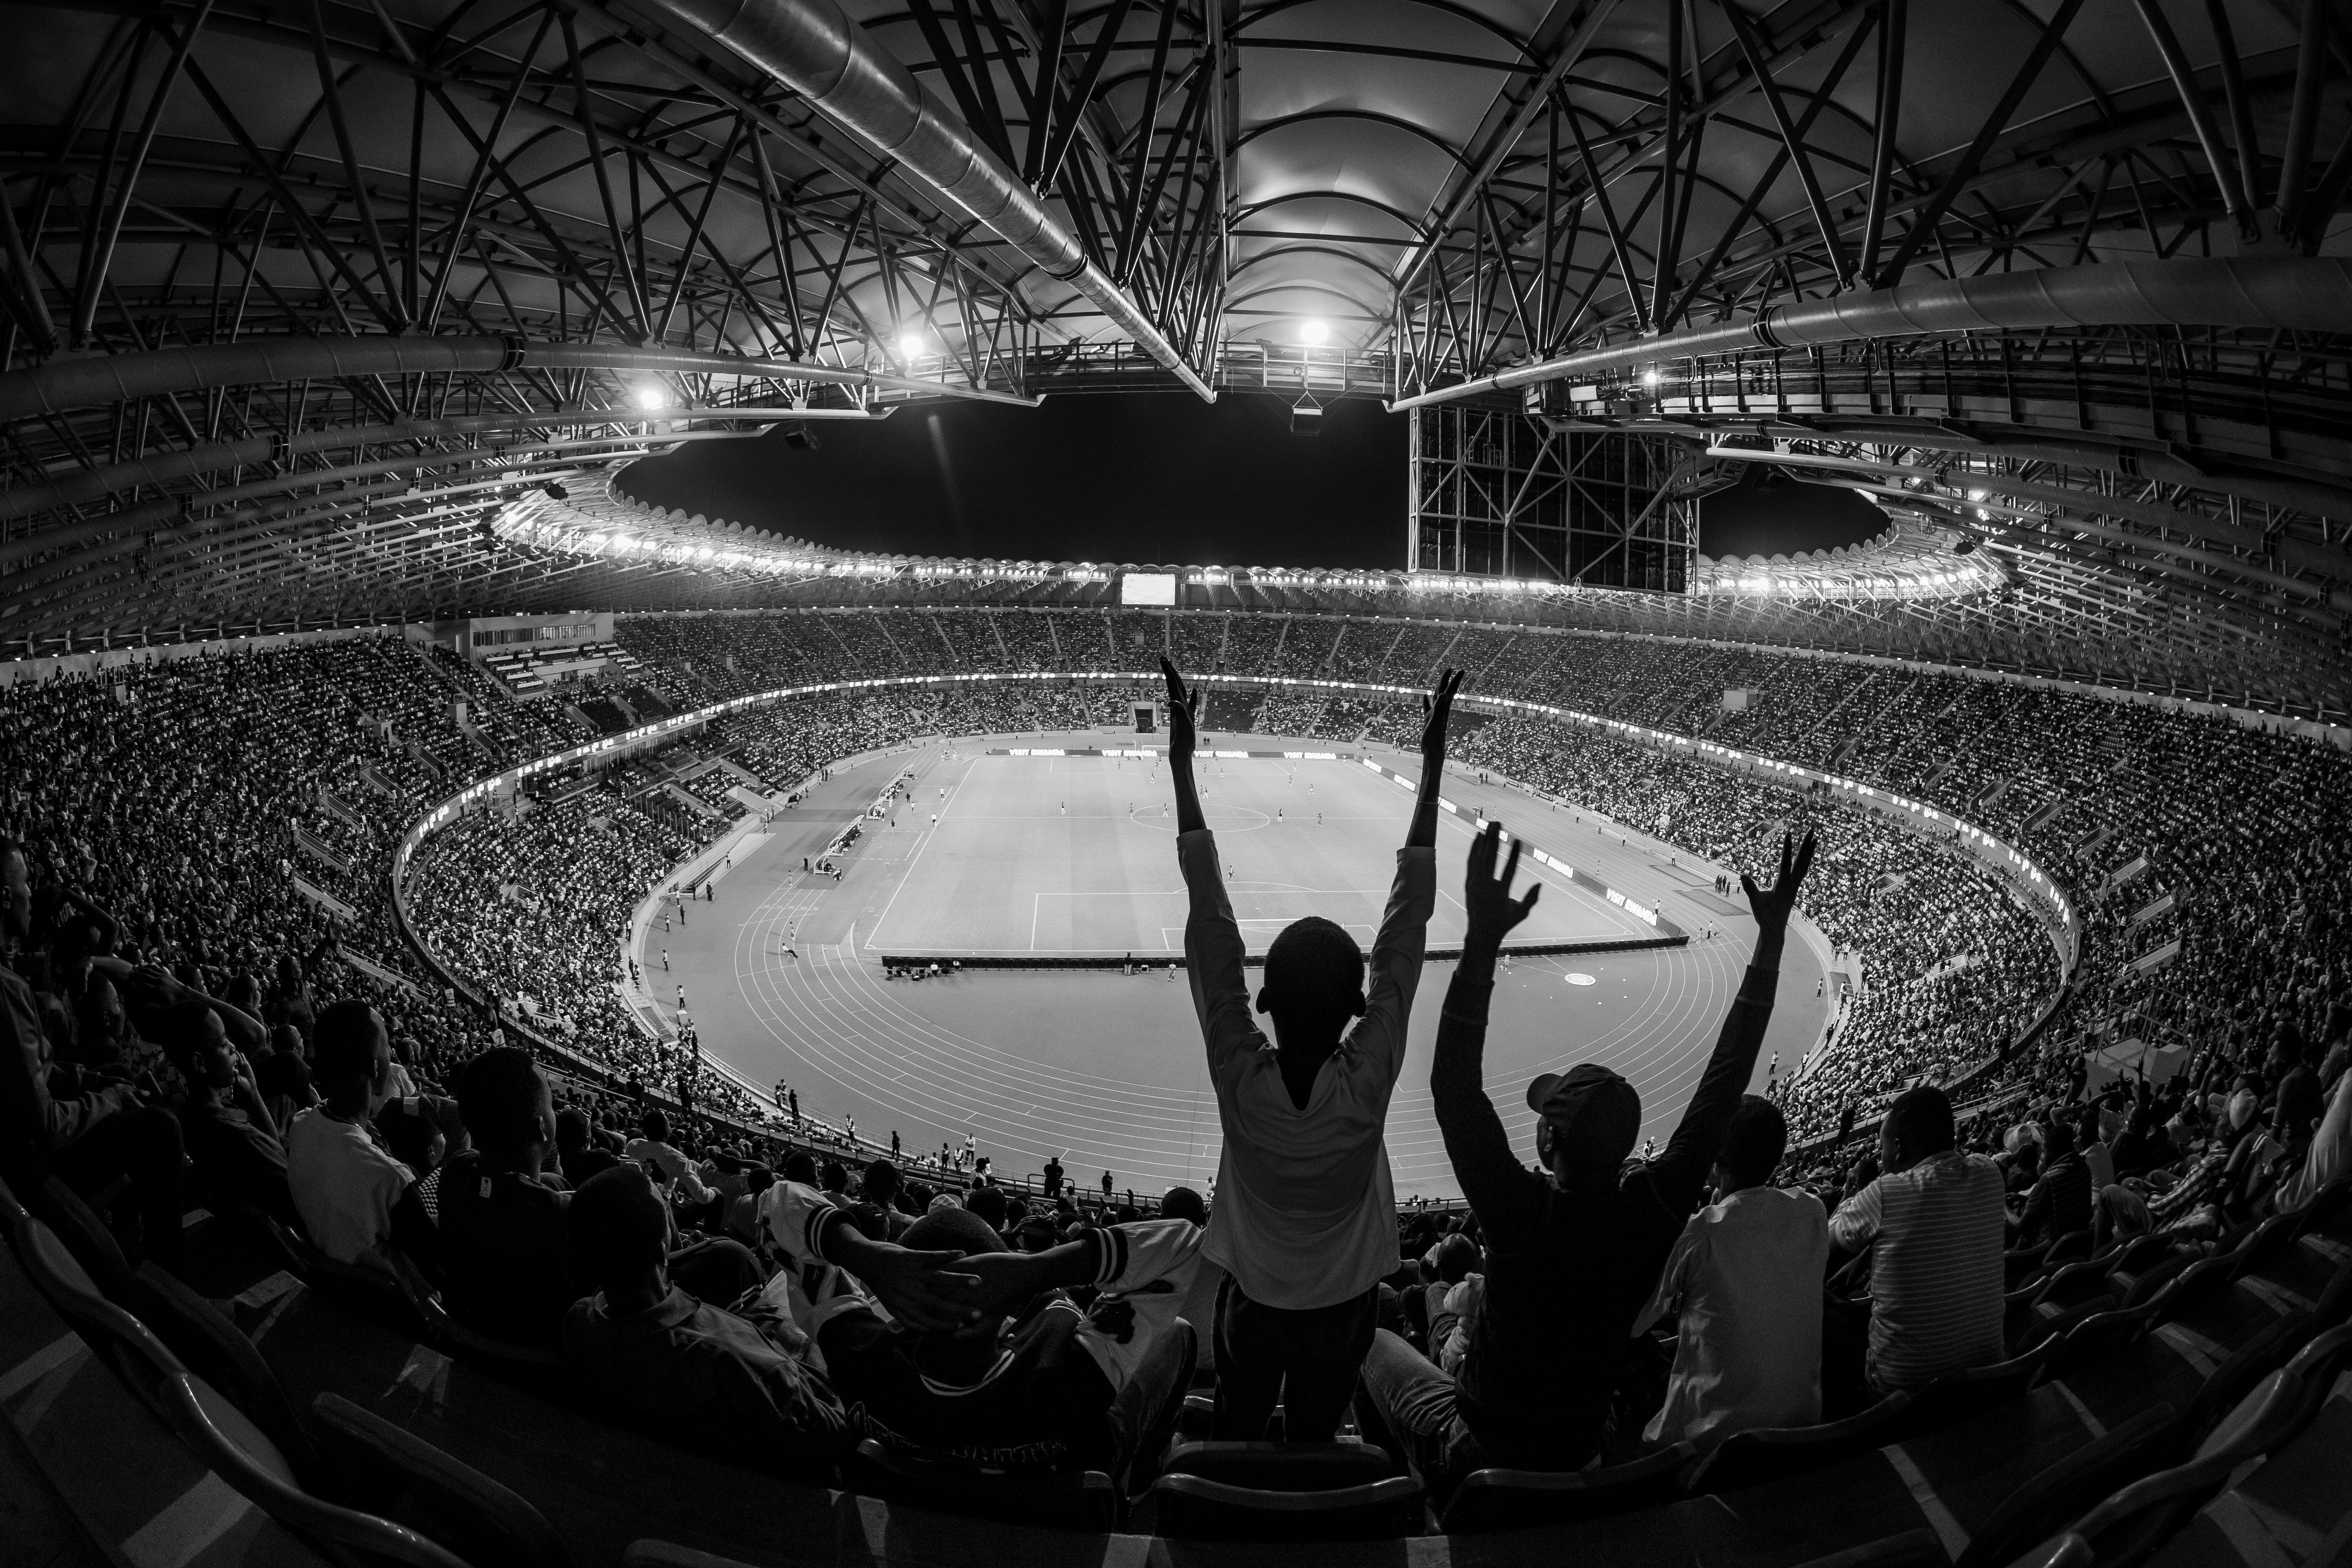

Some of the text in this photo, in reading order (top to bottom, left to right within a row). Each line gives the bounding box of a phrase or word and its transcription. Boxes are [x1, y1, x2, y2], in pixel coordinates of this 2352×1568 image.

[1533, 848, 1549, 863] VISIT
[1606, 888, 1657, 926] VISIT RWANDA
